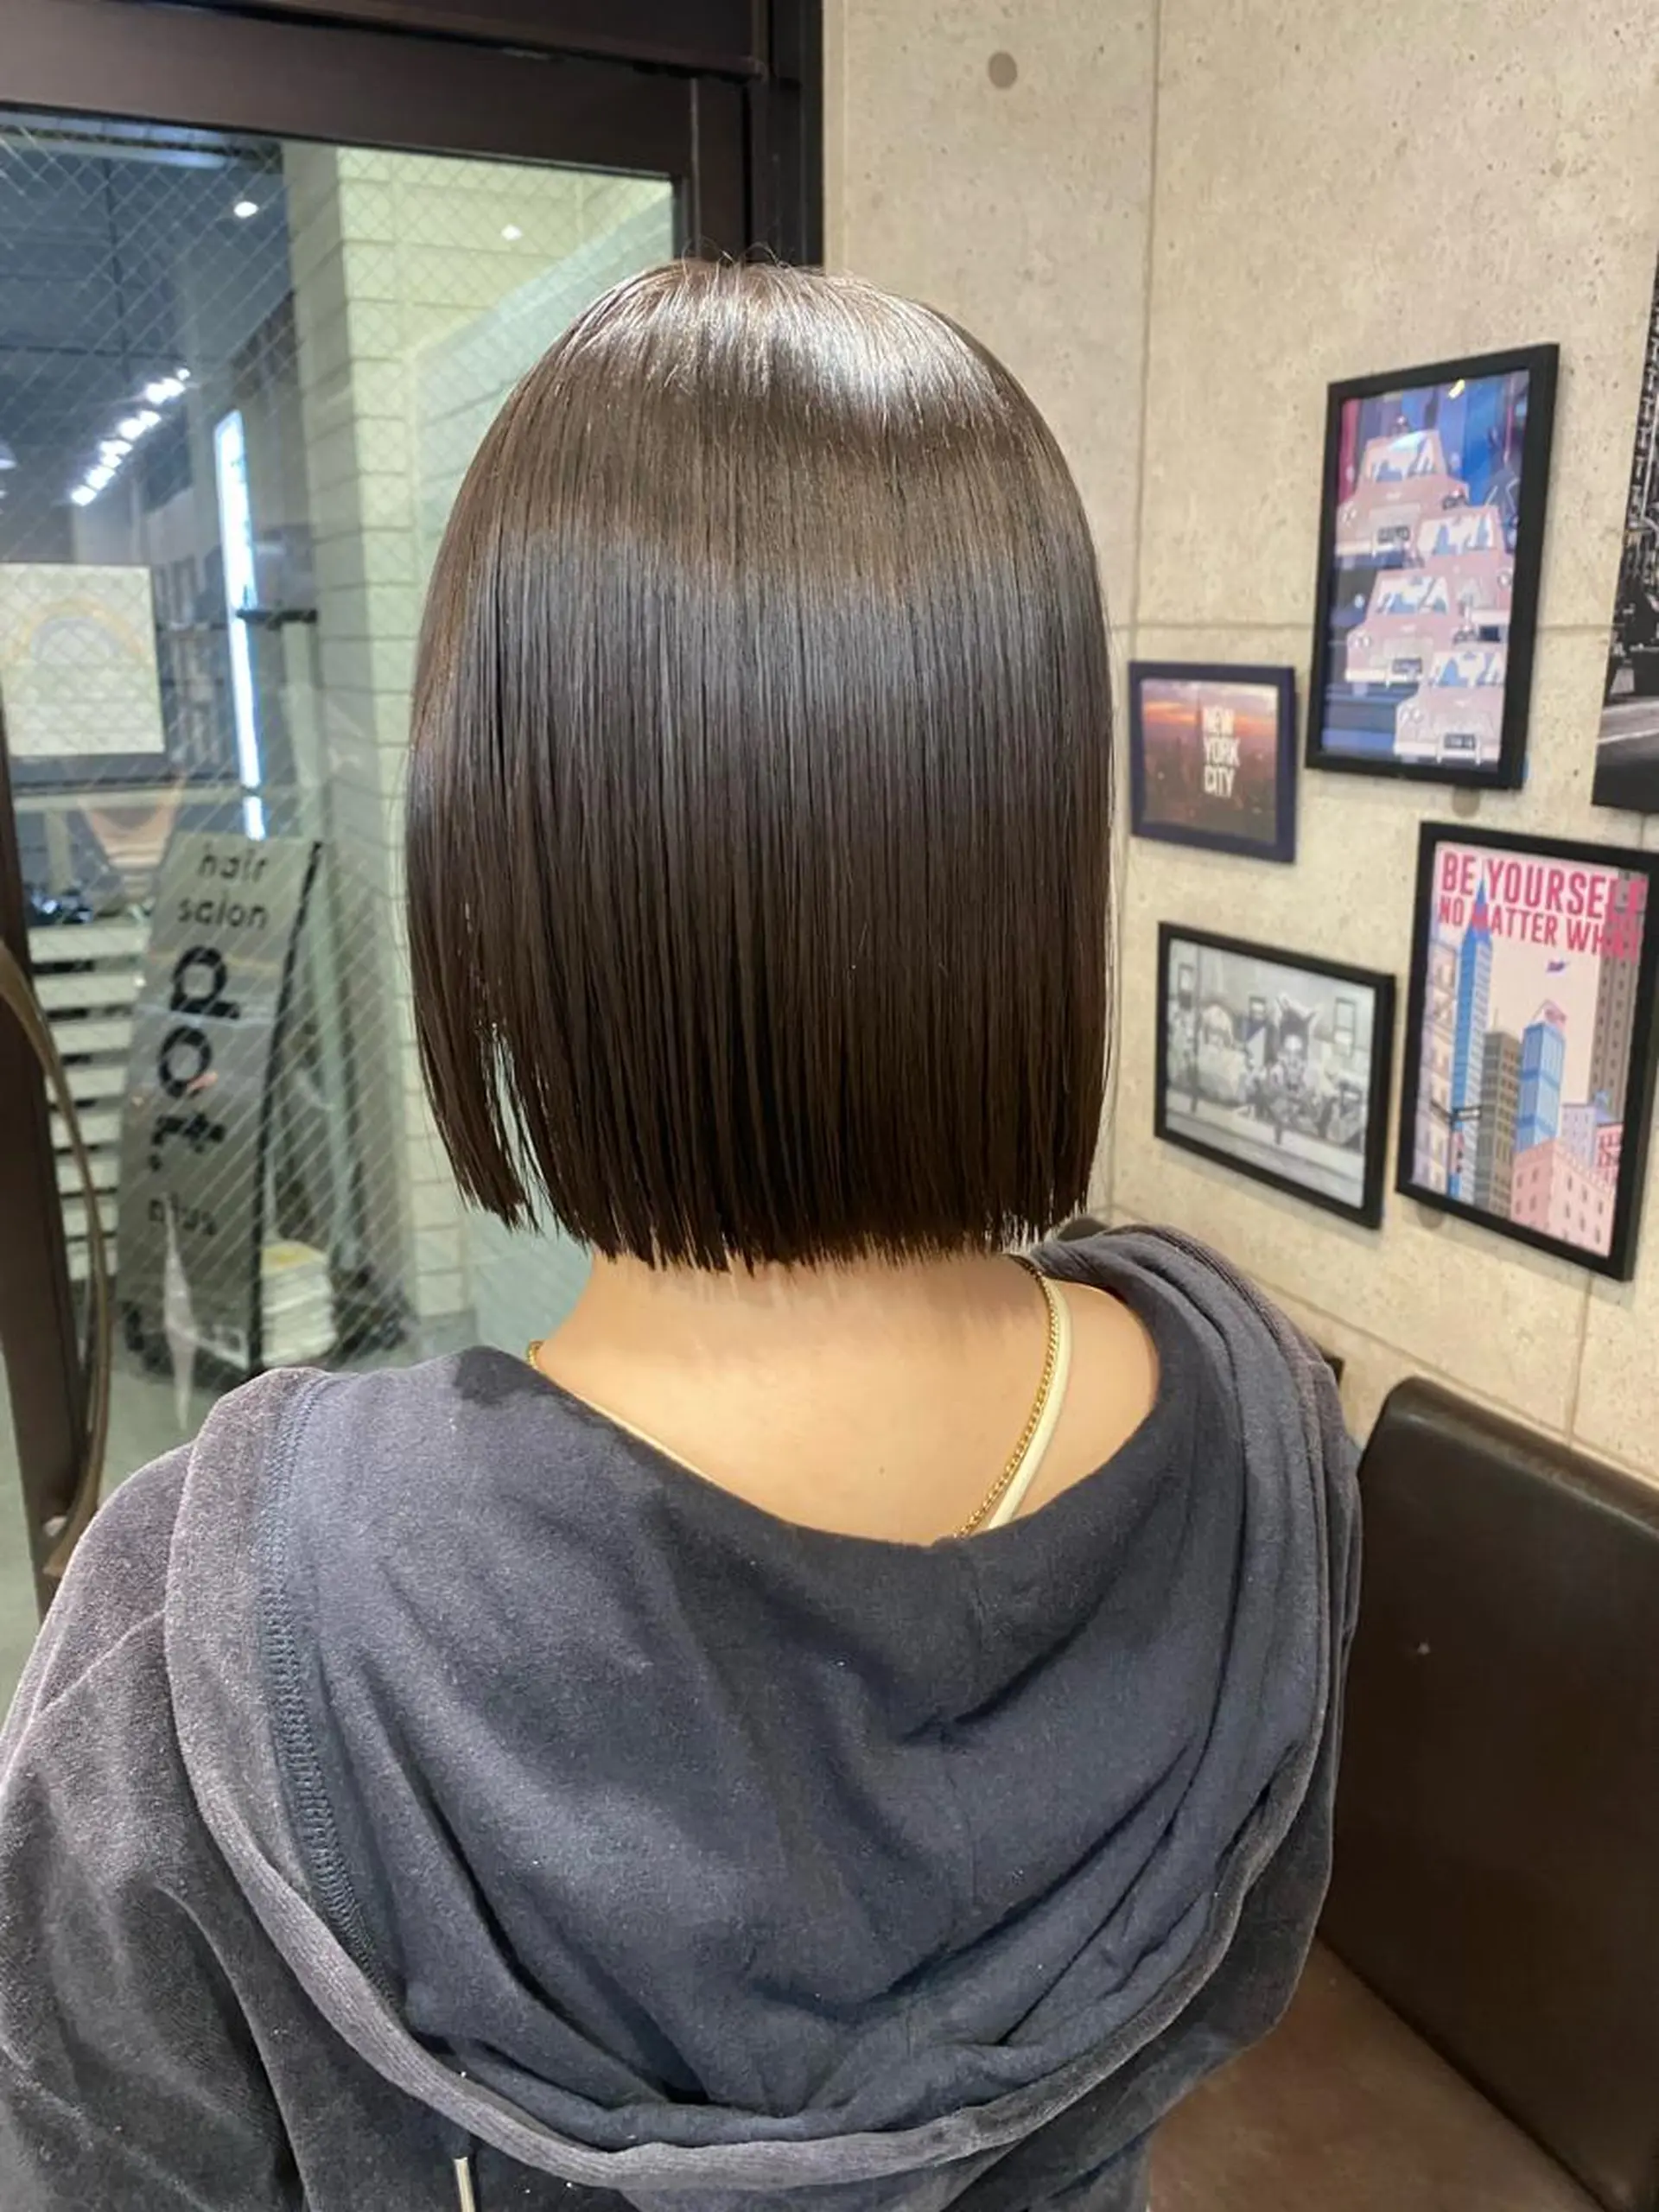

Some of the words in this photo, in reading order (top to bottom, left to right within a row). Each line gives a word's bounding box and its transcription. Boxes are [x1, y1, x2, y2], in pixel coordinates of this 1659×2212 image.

[1203, 735, 1241, 767] YORK
[1205, 764, 1236, 798] CITY
[197, 842, 268, 882] hair
[1441, 850, 1477, 896] BE
[178, 888, 270, 930] salon
[1439, 894, 1466, 927] NO
[1471, 900, 1559, 947] MATTER
